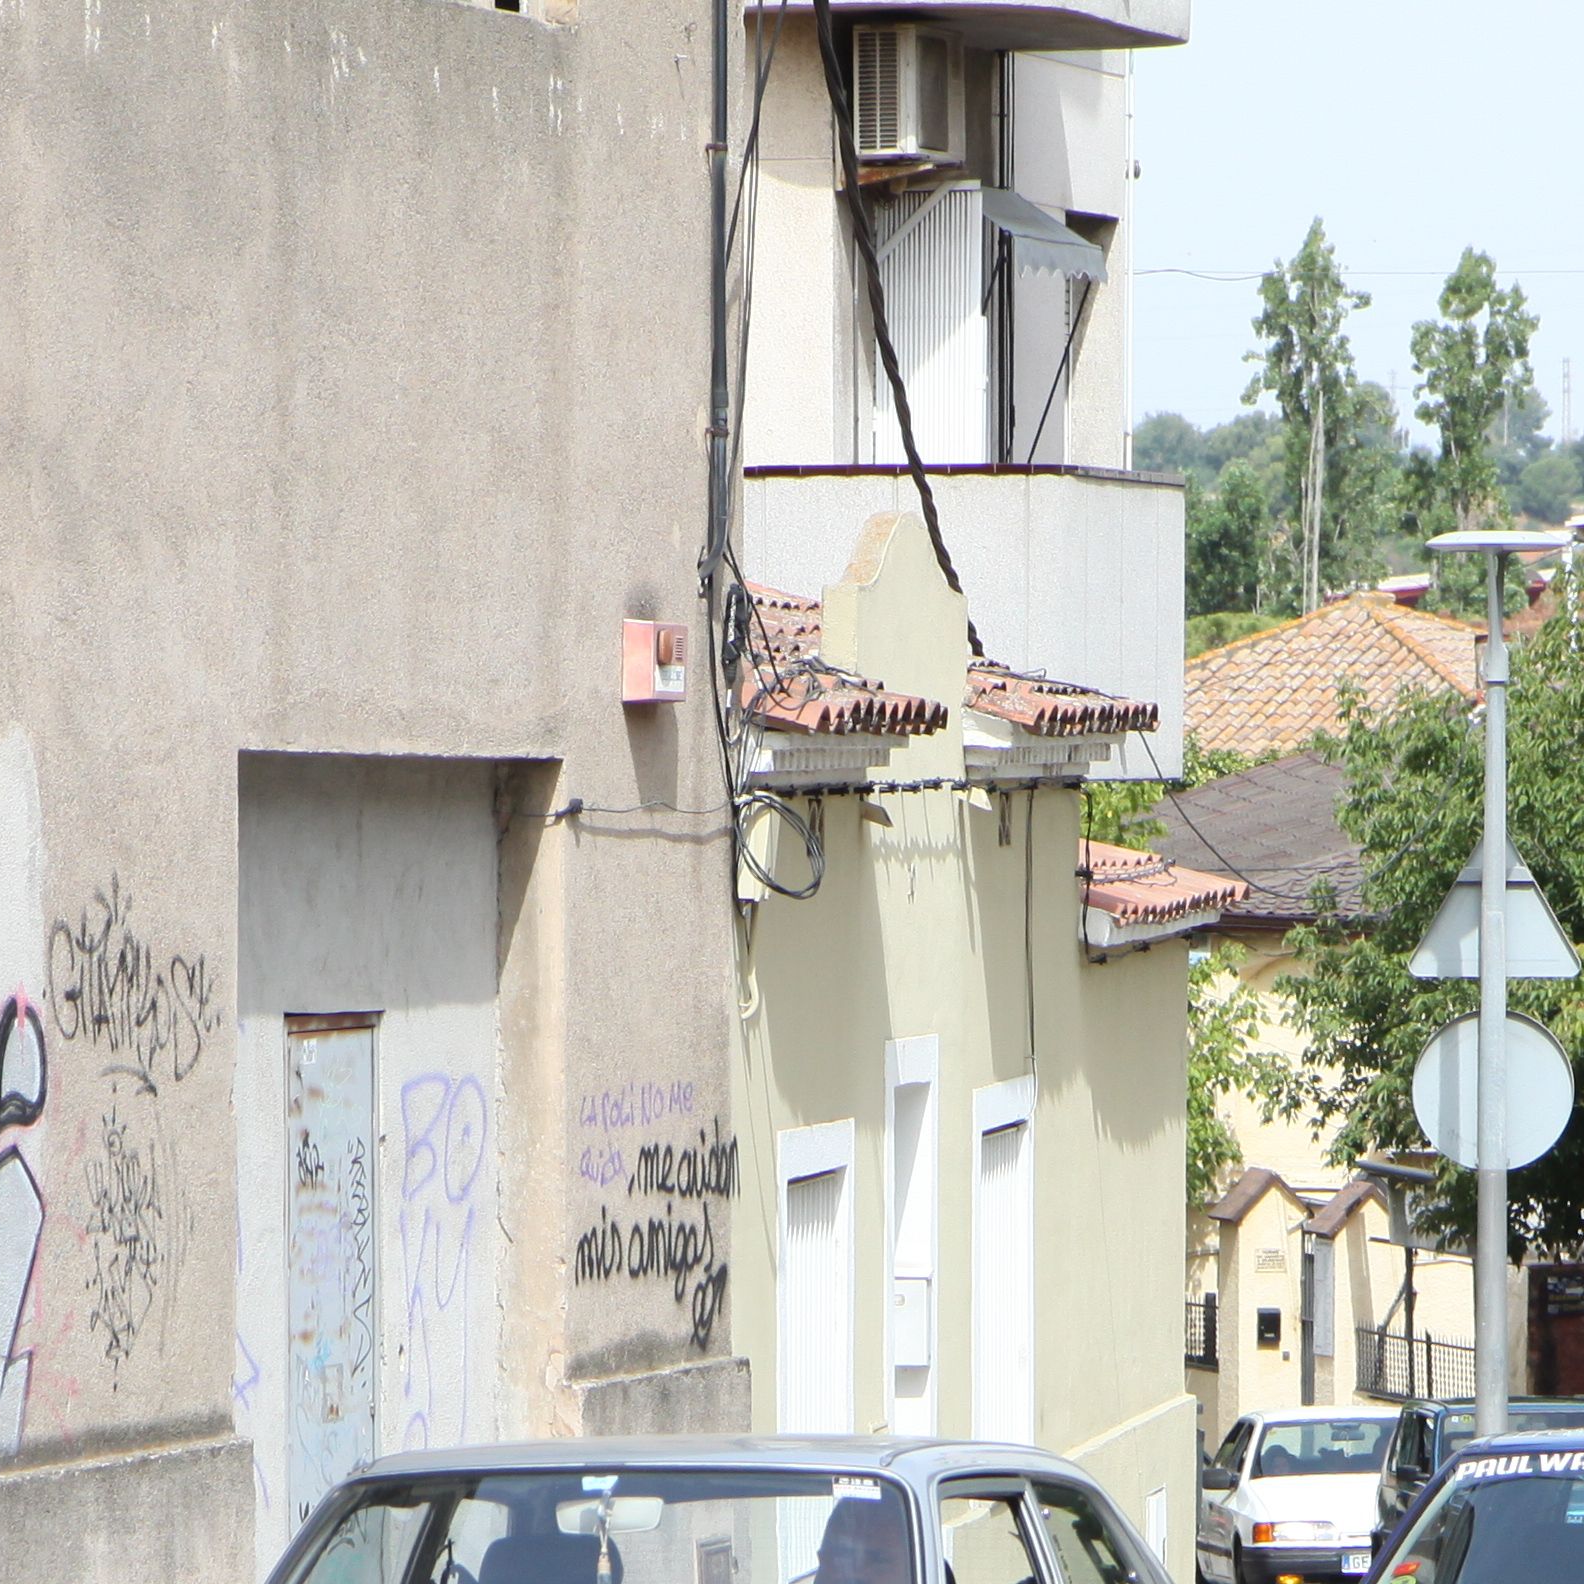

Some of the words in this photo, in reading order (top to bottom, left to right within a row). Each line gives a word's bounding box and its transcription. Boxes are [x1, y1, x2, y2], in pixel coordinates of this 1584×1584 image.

[575, 1204, 622, 1287] mis
[627, 1201, 714, 1304] amigas
[1455, 1455, 1534, 1482] PAUL
